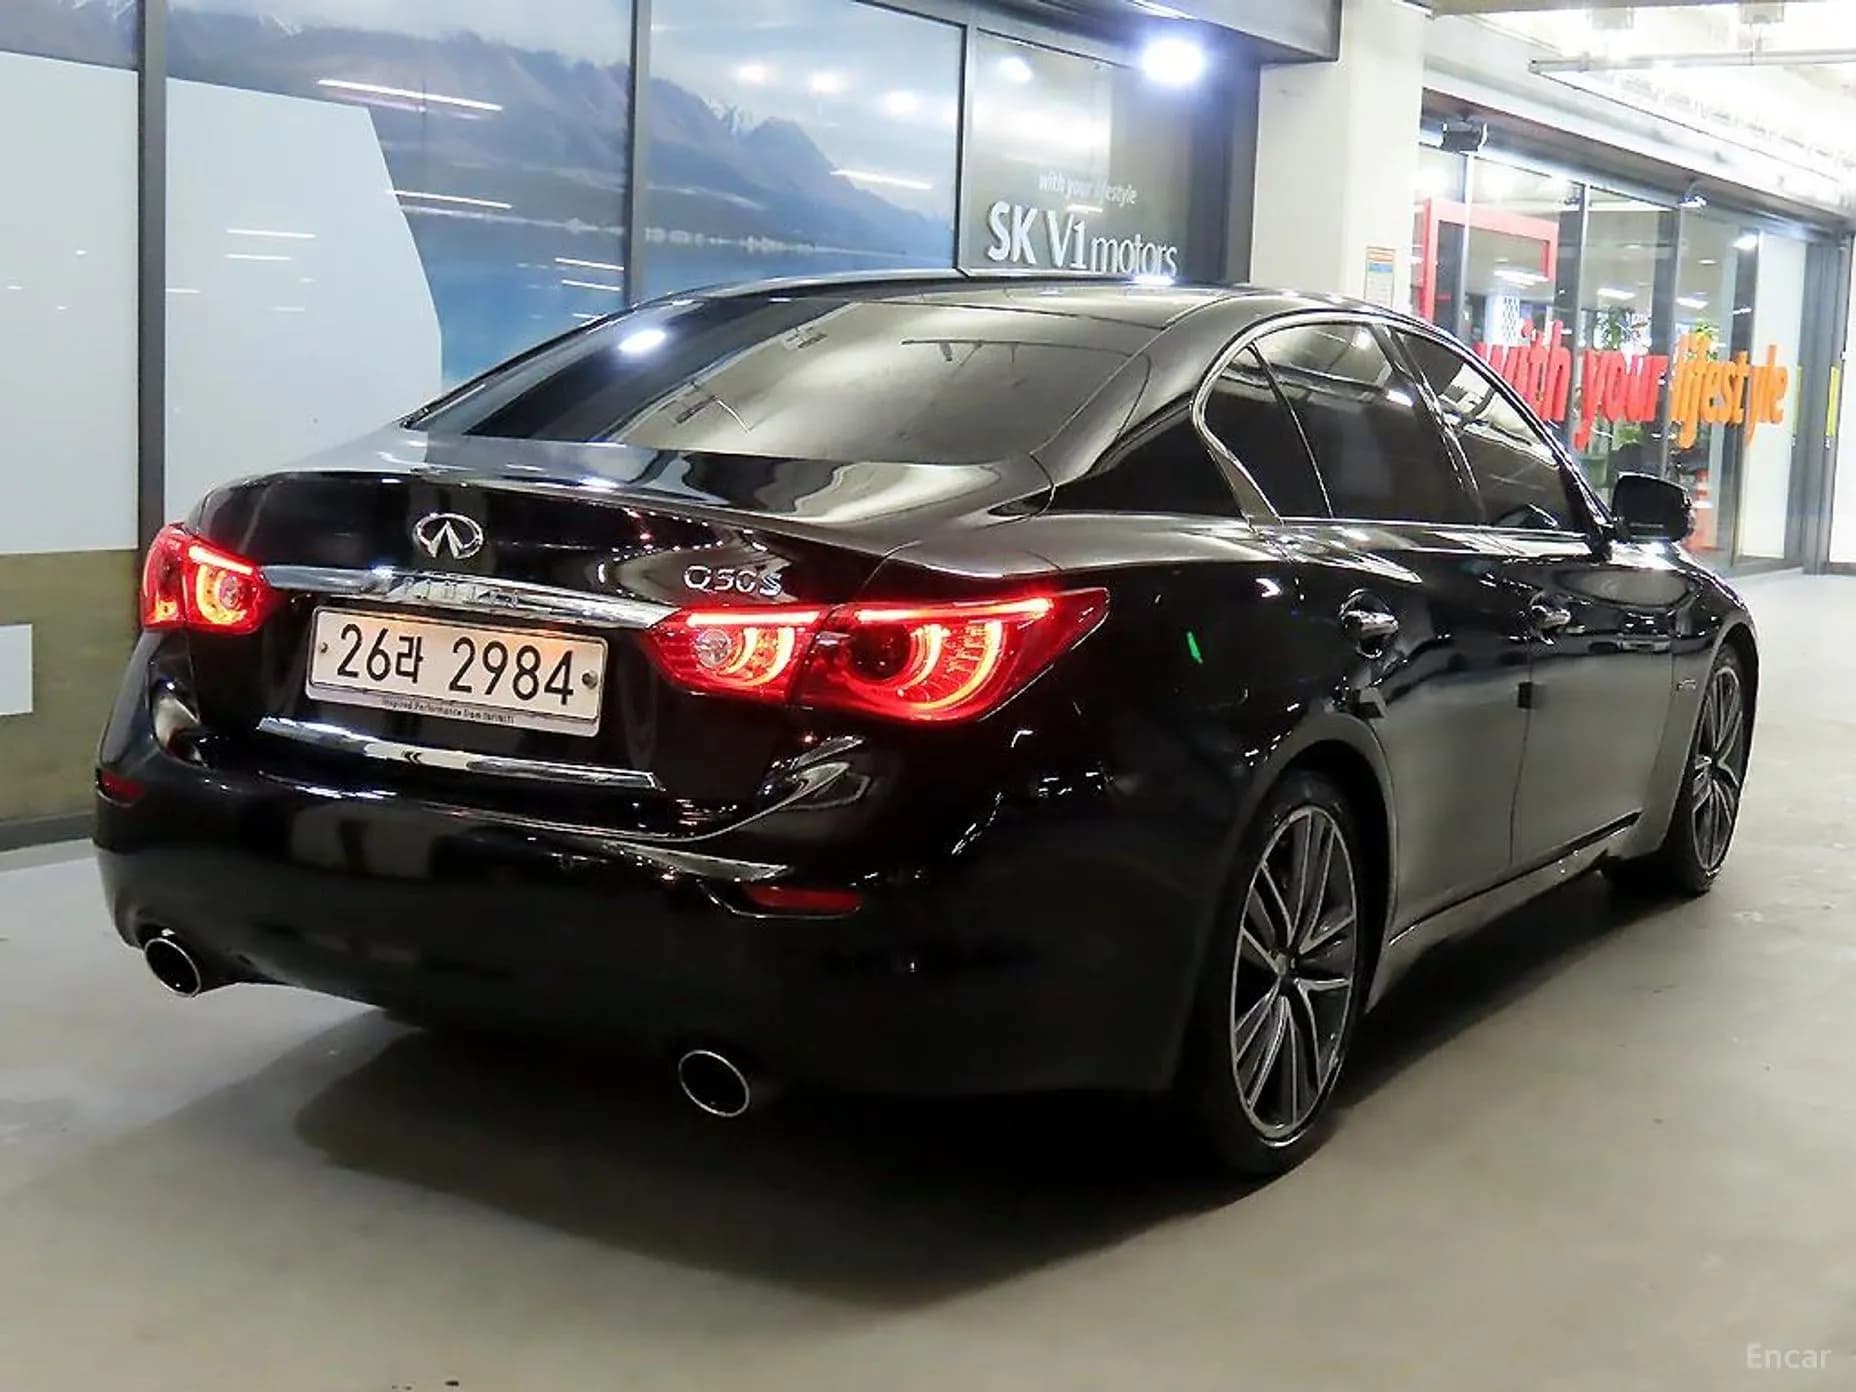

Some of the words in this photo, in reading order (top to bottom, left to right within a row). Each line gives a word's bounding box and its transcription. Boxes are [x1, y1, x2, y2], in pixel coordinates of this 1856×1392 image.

[1039, 171, 1066, 193] with
[988, 201, 1038, 265] SK
[1572, 348, 1669, 450] your
[1669, 332, 1788, 449] lifestyle
[337, 623, 424, 684] 26라
[449, 637, 574, 705] 2984
